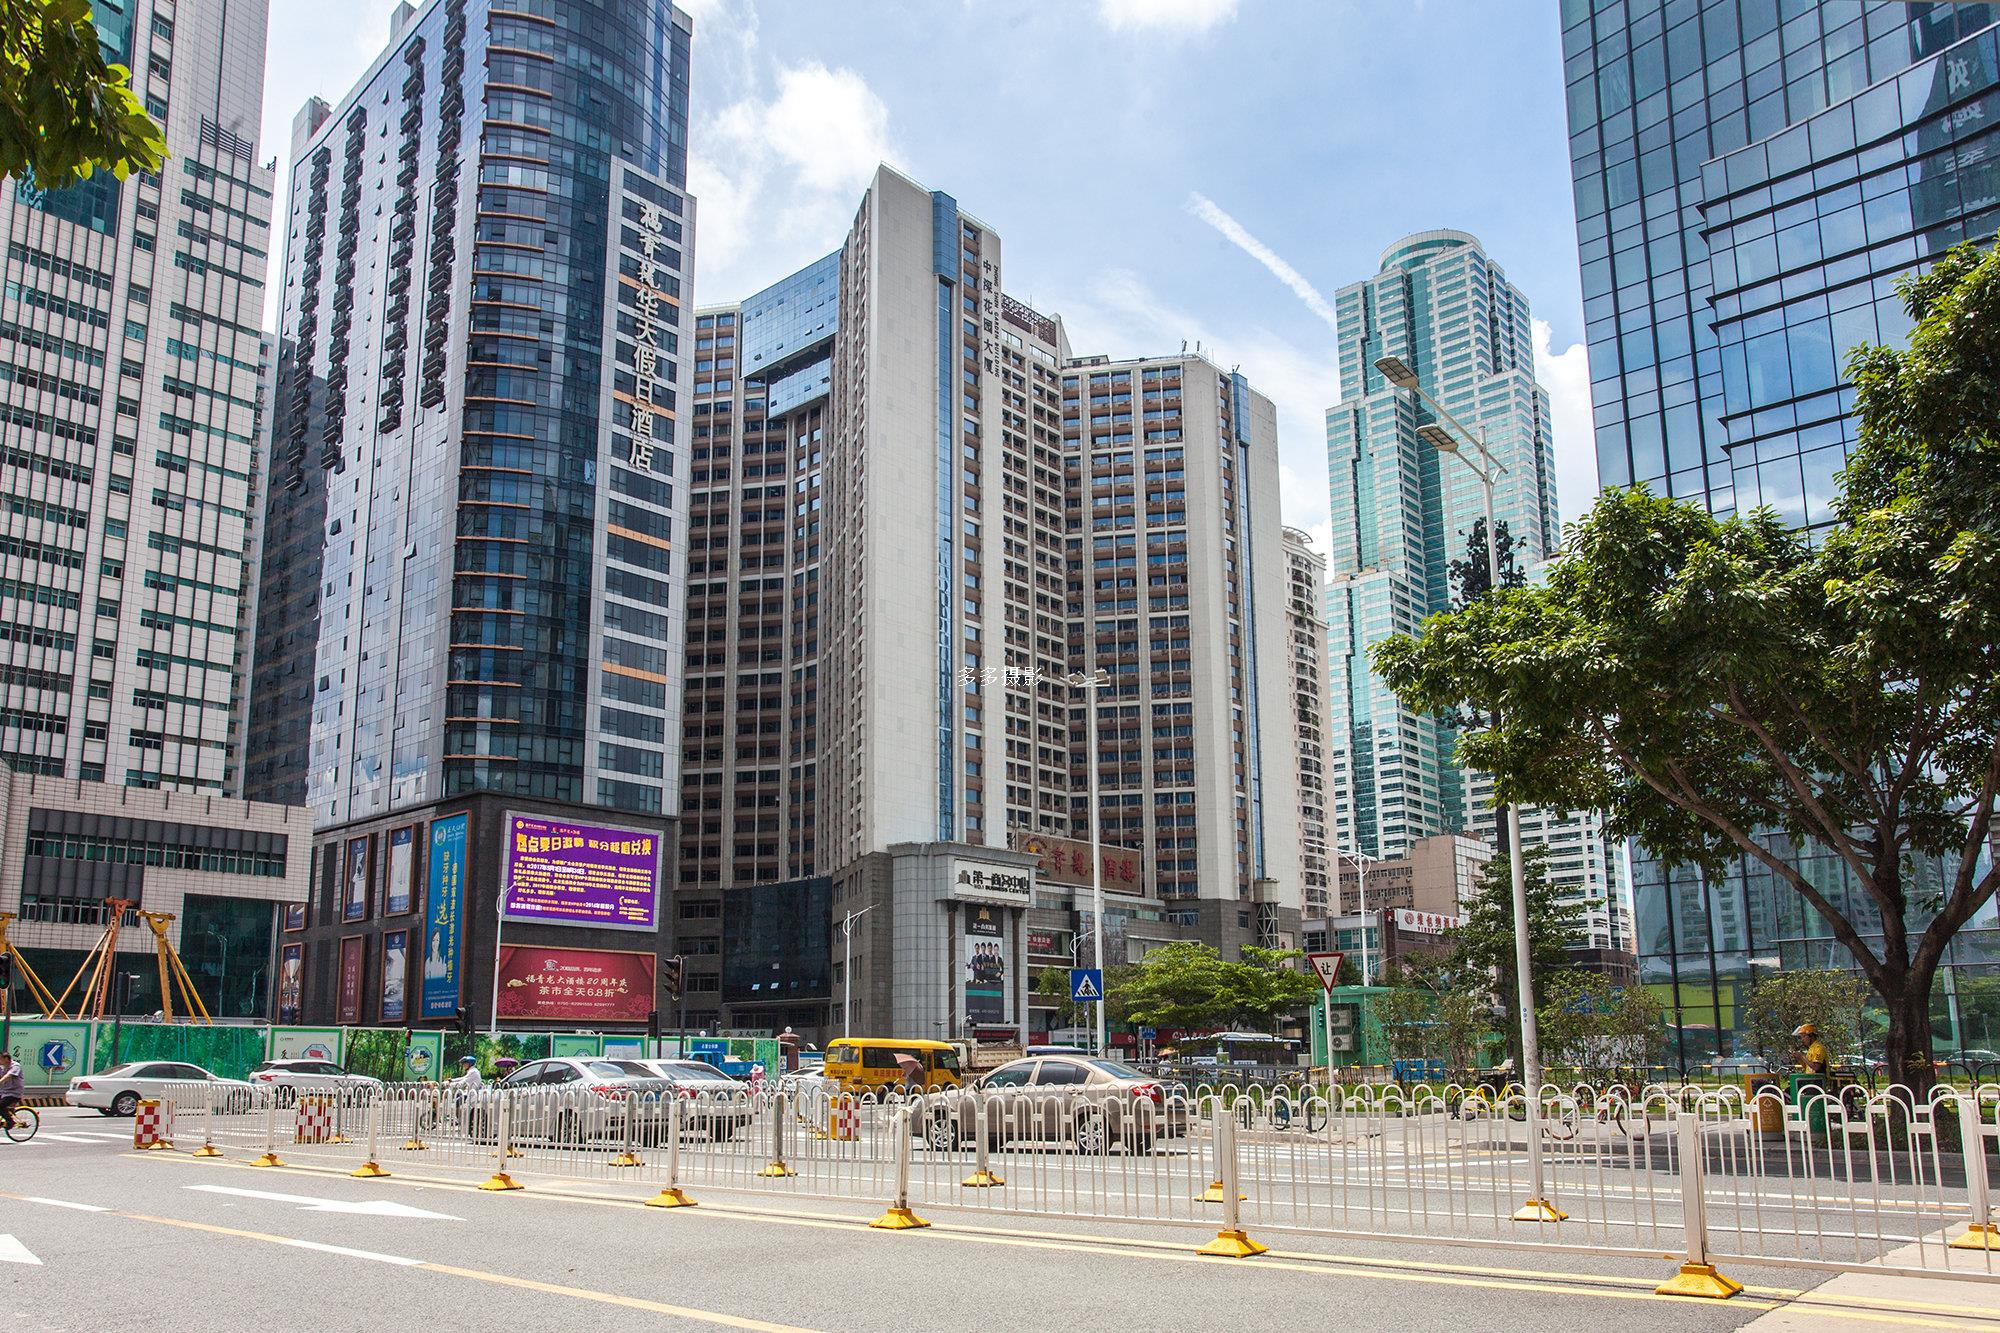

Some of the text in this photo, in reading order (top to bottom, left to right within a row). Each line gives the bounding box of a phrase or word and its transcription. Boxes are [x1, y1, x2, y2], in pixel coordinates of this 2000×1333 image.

[983, 260, 993, 374] 中深花园大厦
[588, 838, 652, 855] 积分超值兑换
[985, 885, 1008, 893] BUSINESS
[1321, 962, 1332, 975] 让
[539, 986, 614, 998] 茶市全天6.8折
